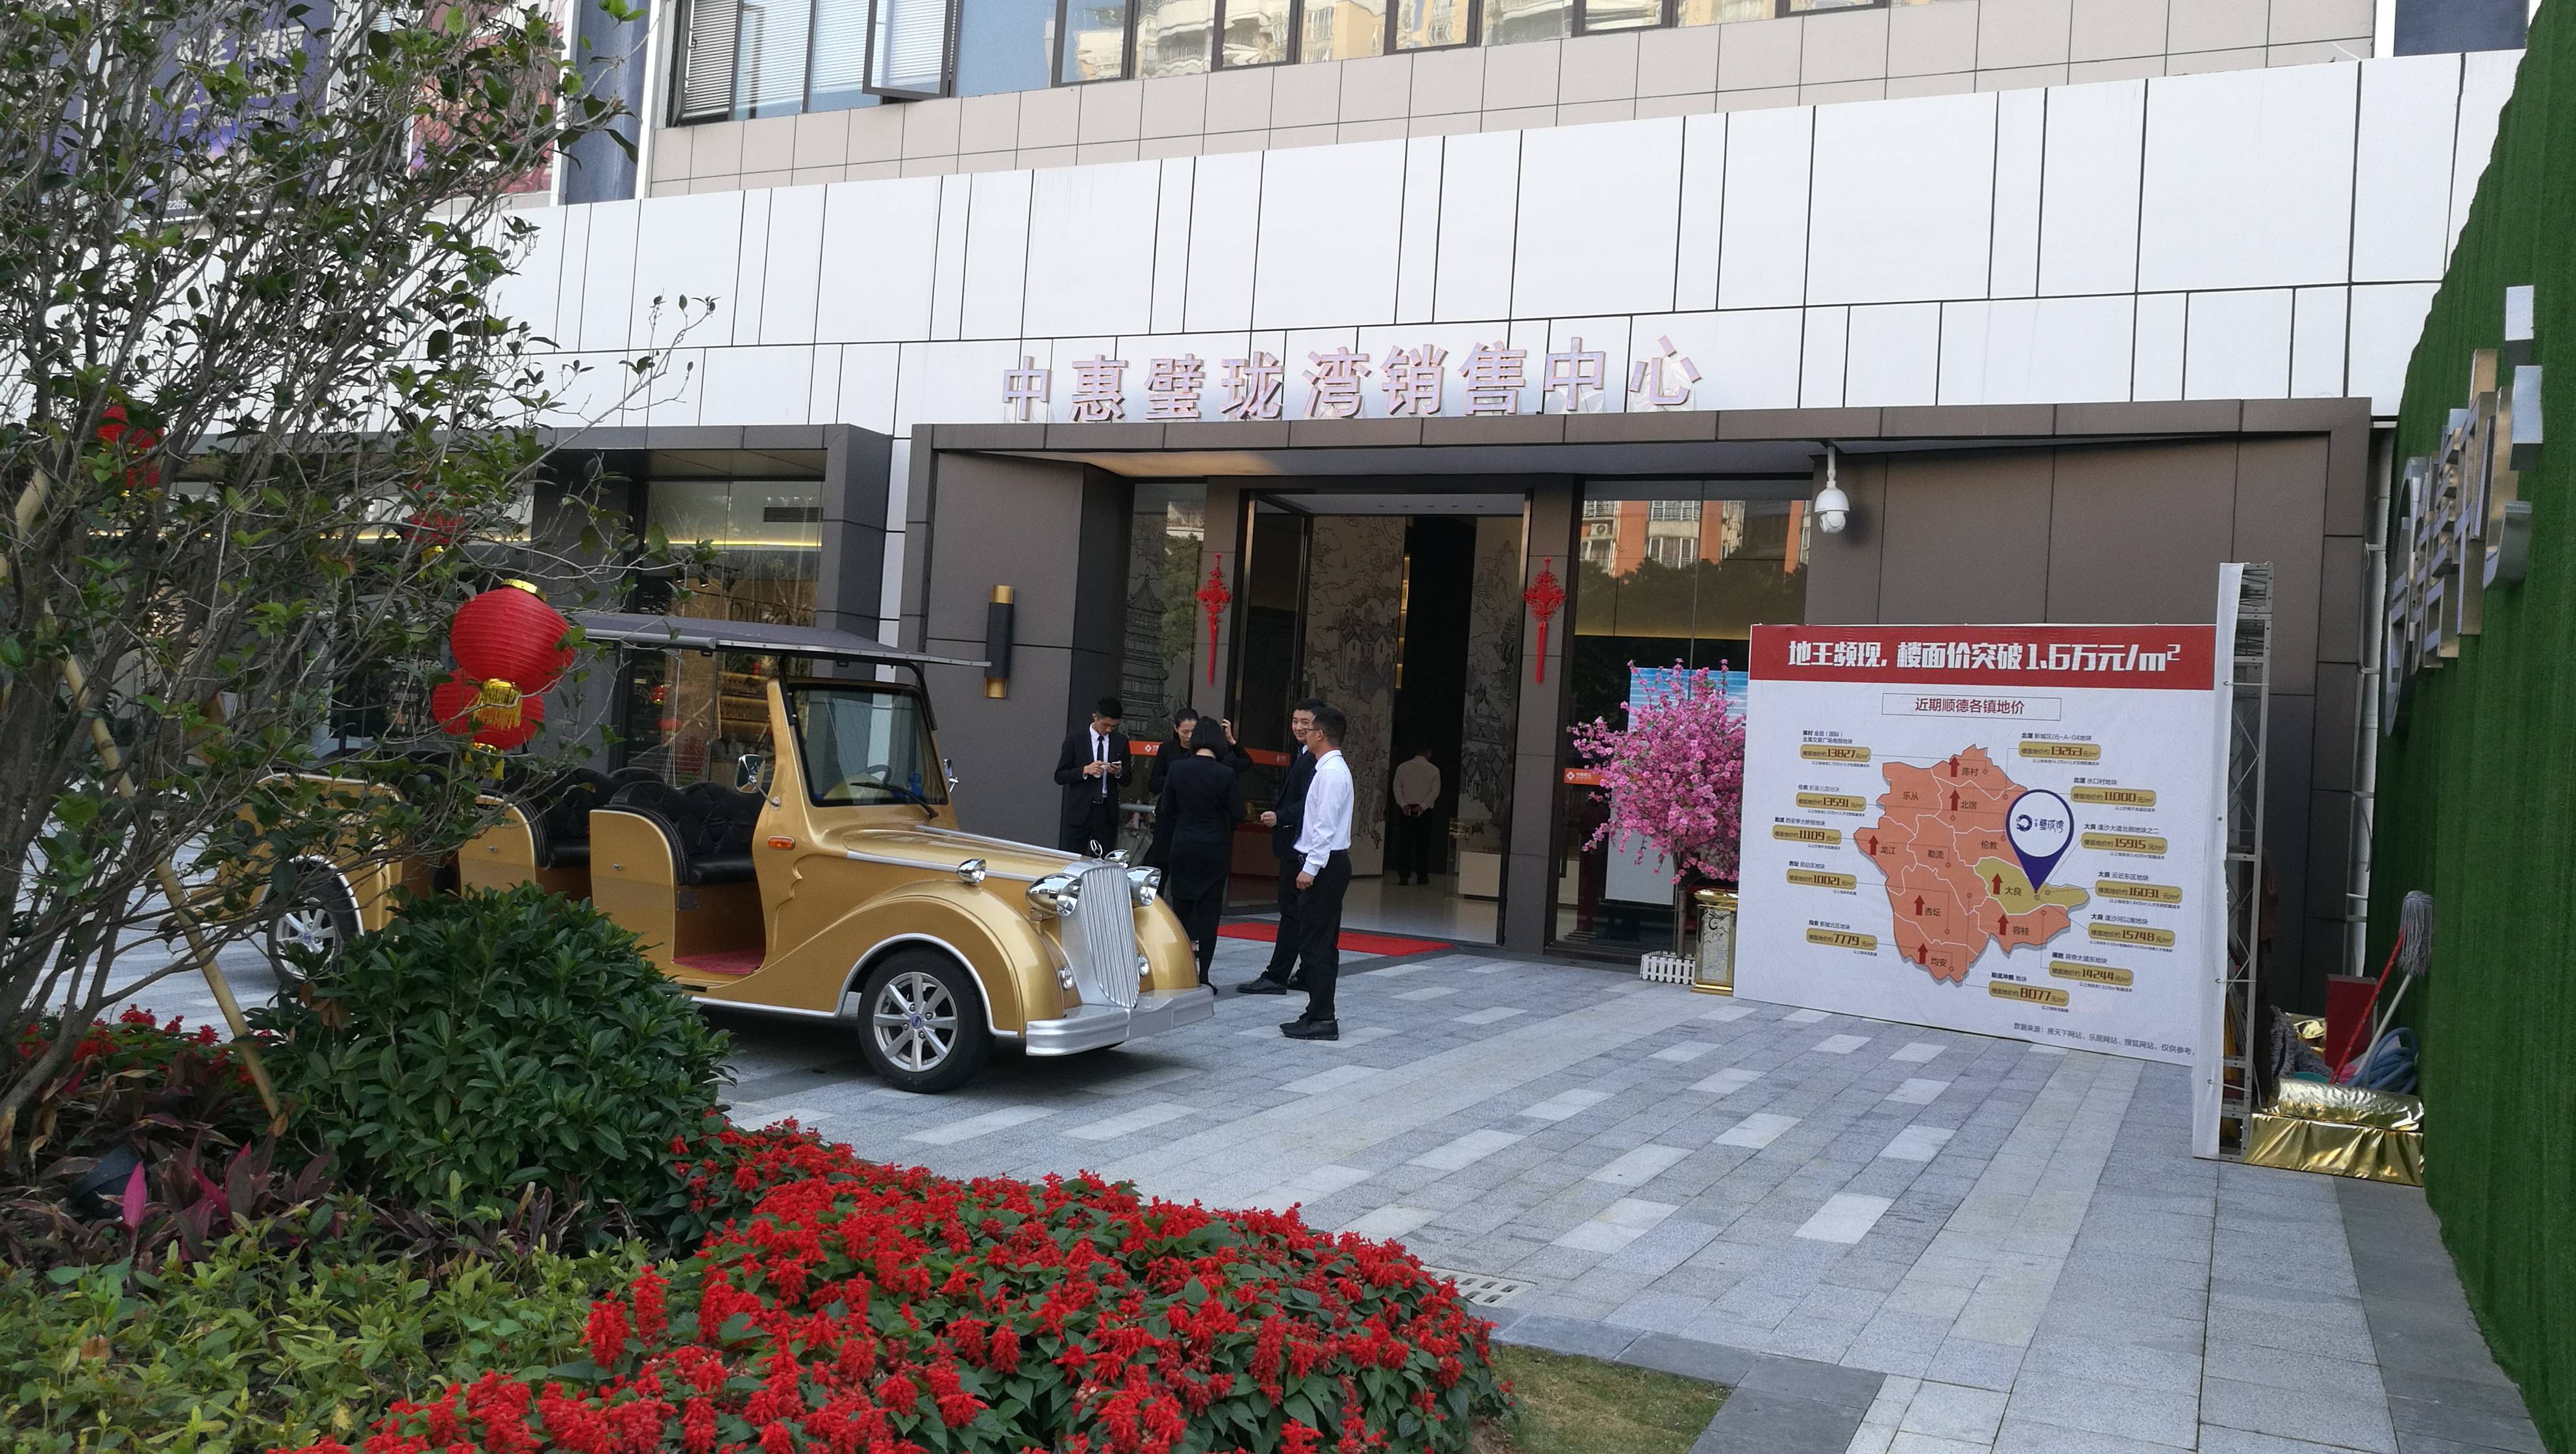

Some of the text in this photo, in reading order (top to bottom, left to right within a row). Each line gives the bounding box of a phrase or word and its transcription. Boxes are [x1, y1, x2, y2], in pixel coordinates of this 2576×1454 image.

[1002, 336, 1701, 422] 中惠璧珑湾销售中心
[1915, 698, 2025, 714] 近期顺德各镇地价
[1962, 767, 1979, 776] 陈村
[1903, 791, 1919, 800] 乐从
[1960, 800, 1977, 810] 北滘
[1981, 841, 1998, 850] 伦教
[1880, 846, 1896, 855] 龙江
[1927, 850, 1944, 859] 勒流
[2005, 887, 2022, 896] 大良
[1925, 908, 1941, 917] 杏坛
[2012, 926, 2030, 936] 容桂
[1931, 957, 1947, 967] 均安
